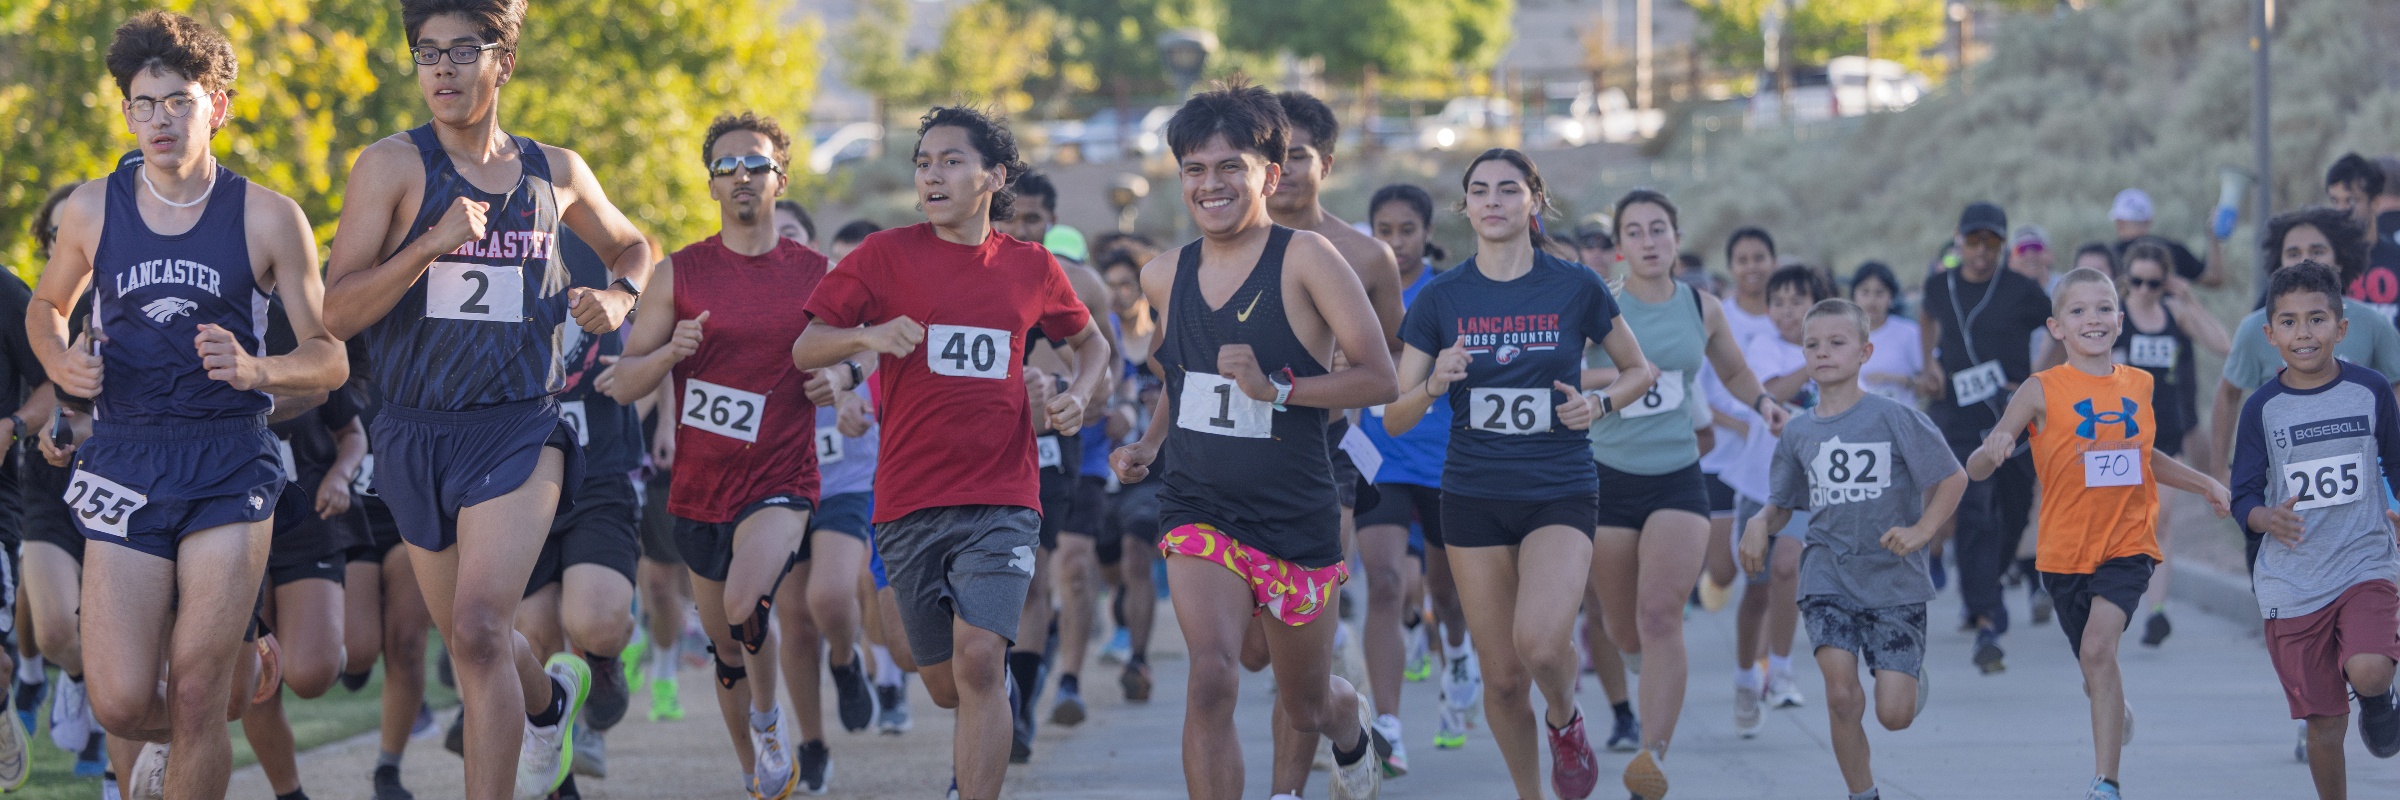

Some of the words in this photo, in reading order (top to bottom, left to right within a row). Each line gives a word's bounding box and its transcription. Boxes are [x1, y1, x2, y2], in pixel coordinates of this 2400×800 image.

[116, 258, 222, 299] LANCASTER
[459, 270, 490, 315] 2
[1457, 313, 1560, 335] LANCASTER
[1457, 333, 1497, 347] ROSS
[1503, 331, 1560, 345] COUNTRY
[941, 332, 996, 372] 40
[687, 388, 755, 432] 262
[1209, 383, 1236, 429] 1
[1483, 393, 1536, 430] 26
[2294, 421, 2366, 441] BASEBALL
[1827, 448, 1878, 484] 82
[2094, 454, 2130, 477] 70
[2289, 462, 2359, 503] 265
[68, 480, 137, 526] 255
